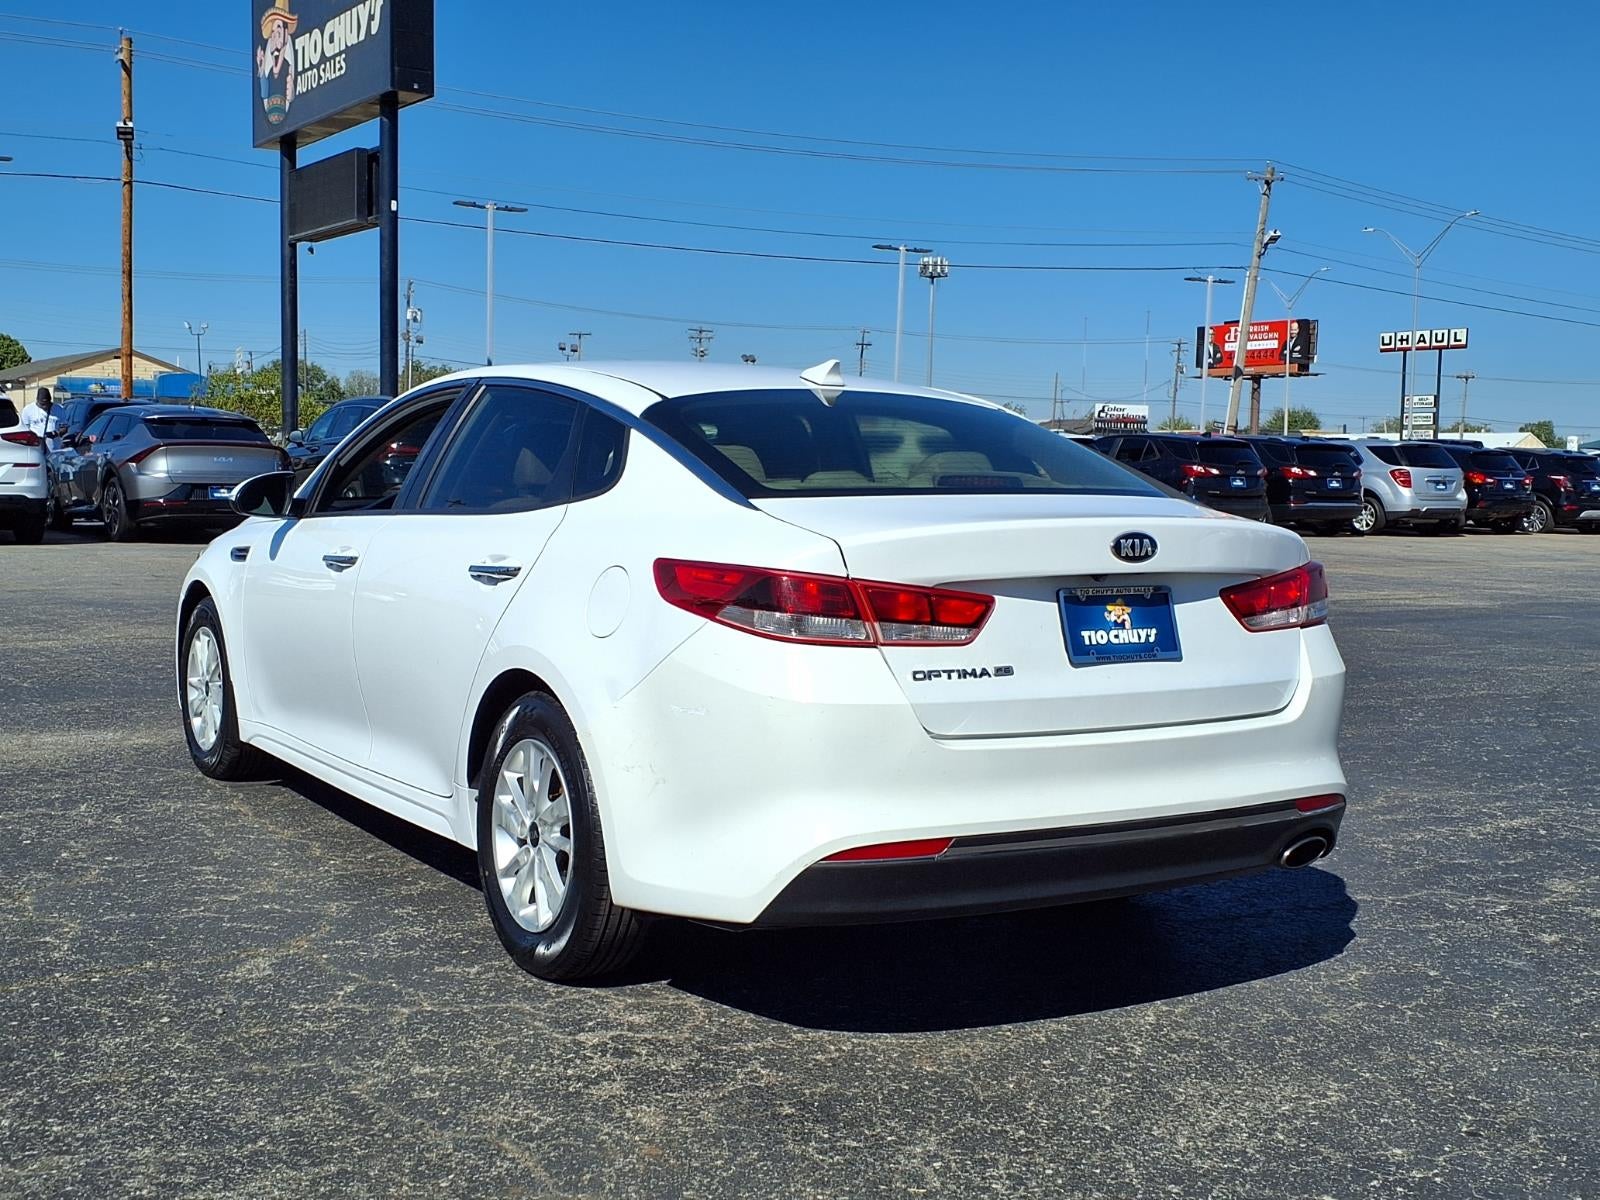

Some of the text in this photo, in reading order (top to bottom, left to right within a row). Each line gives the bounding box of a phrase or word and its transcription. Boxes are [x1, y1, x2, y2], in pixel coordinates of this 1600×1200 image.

[294, 0, 384, 72] TIO CHUY'S
[296, 53, 346, 96] AUTO SALES
[1098, 411, 1146, 420] Creations
[1102, 405, 1127, 413] Color
[1120, 538, 1152, 556] KIA
[1081, 628, 1157, 646] TIO CHUY'S
[912, 667, 992, 681] OPTIMA
